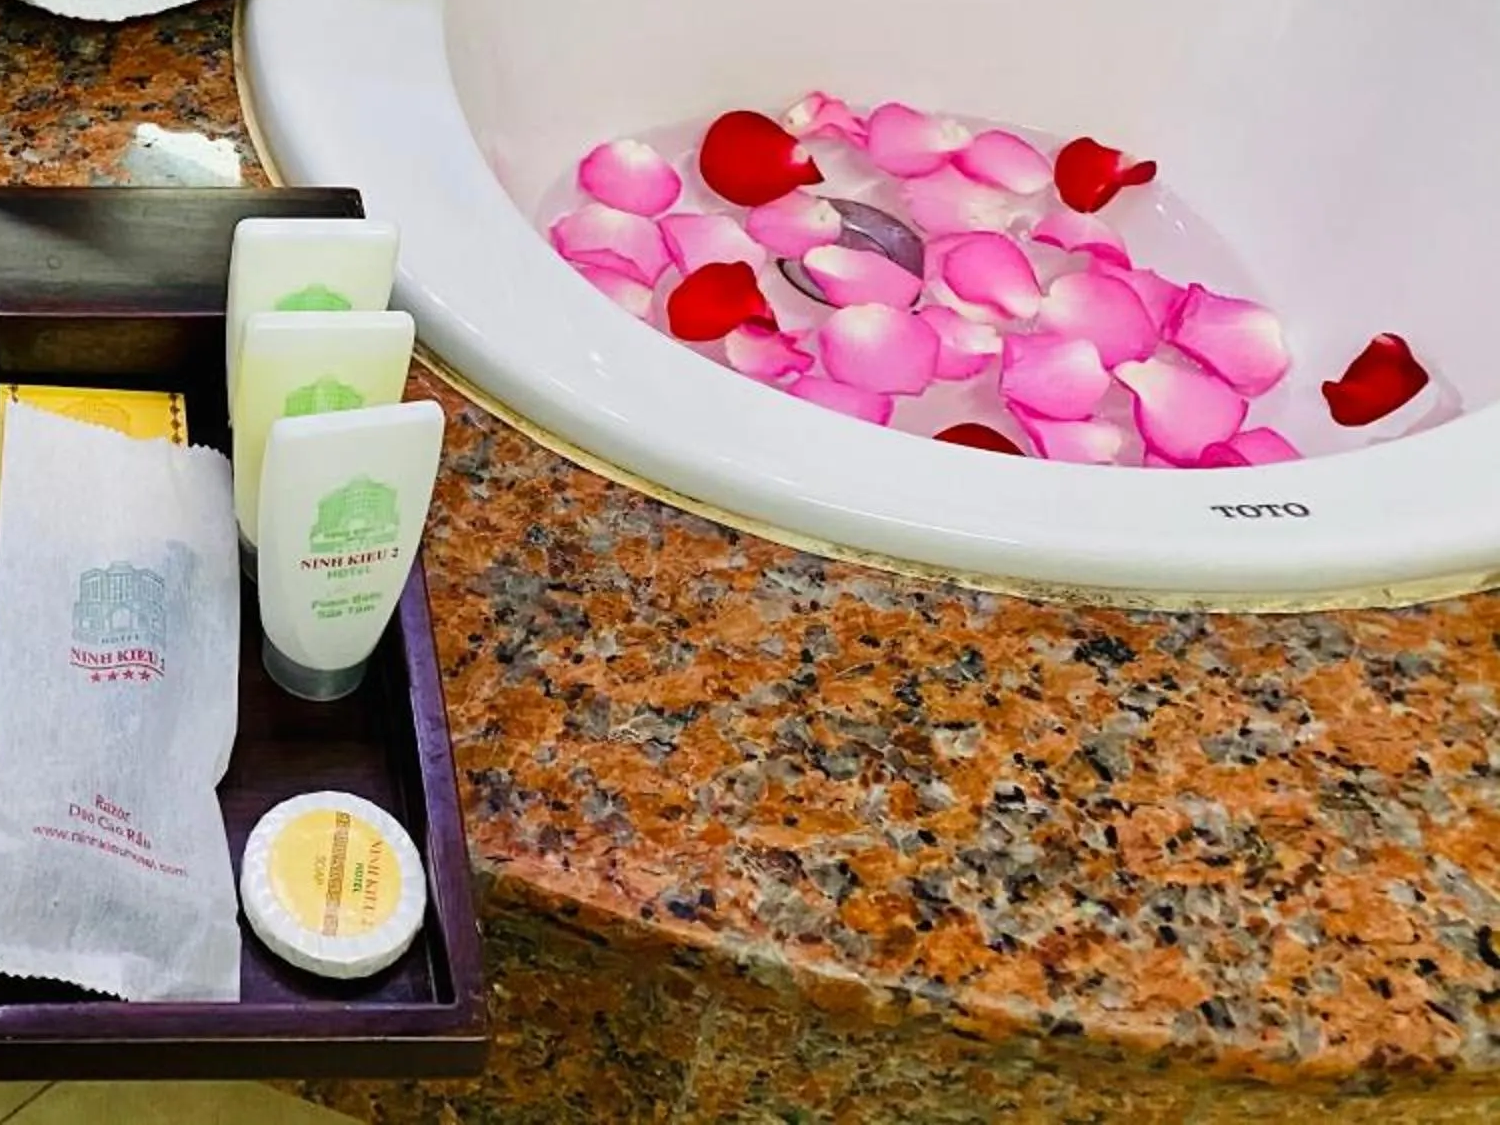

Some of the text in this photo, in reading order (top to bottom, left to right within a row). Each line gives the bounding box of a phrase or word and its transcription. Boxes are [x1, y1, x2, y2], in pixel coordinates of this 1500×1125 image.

[1210, 502, 1310, 518] TOTO
[301, 547, 399, 571] NINH KIEU 2
[70, 647, 113, 665] NINH
[117, 649, 159, 665] KIEU
[313, 854, 328, 885] SOAP
[352, 862, 365, 893] HOTEL
